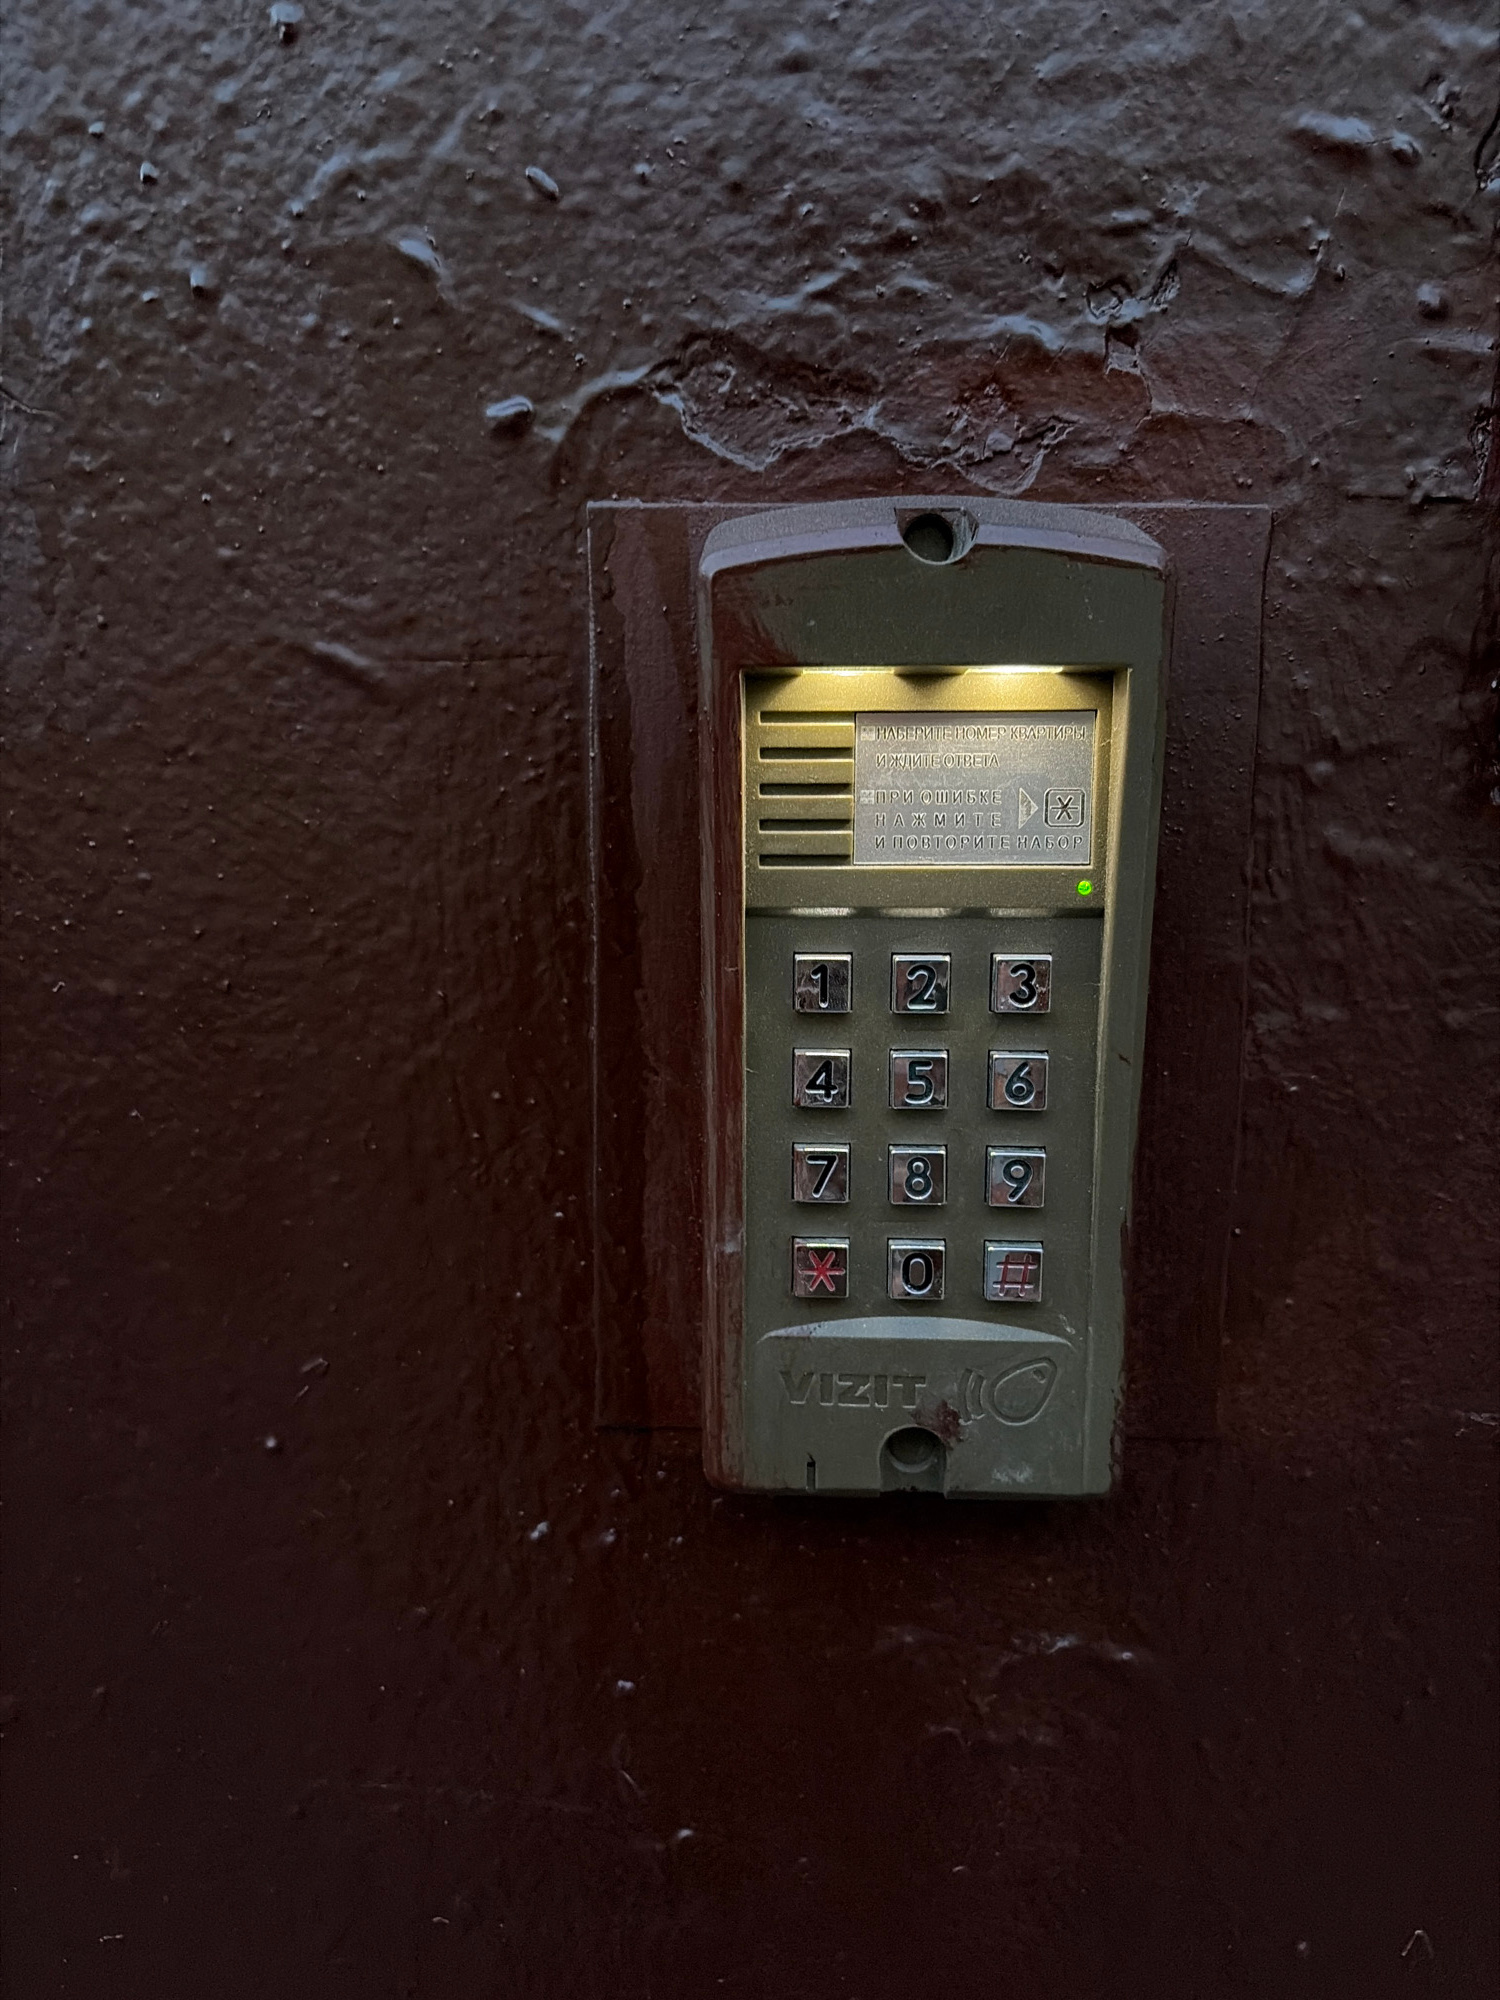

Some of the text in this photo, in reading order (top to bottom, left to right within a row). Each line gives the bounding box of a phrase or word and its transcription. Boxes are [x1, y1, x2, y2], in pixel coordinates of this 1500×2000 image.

[876, 726, 1086, 741] НАБЕРИТЕ НОМЕР КВАРТИРЫ
[875, 753, 1000, 770] И ЖДИТЕ ОТВЕТА
[875, 790, 1002, 805] ПРИ ОШИБКЕ
[875, 812, 1002, 828] НАЖМИТЕ
[875, 835, 1084, 850] И ПОВТОРИТЕ НАБОР
[810, 963, 830, 1009] 1
[906, 964, 937, 1010] 2
[1008, 962, 1038, 1009] 3
[805, 1059, 839, 1103] 4
[904, 1060, 935, 1105] 5
[1004, 1061, 1035, 1106] 6
[806, 1154, 839, 1199] 7
[904, 1156, 934, 1200] 8
[1002, 1159, 1034, 1203] 9
[779, 1370, 928, 1409] VIZIT
